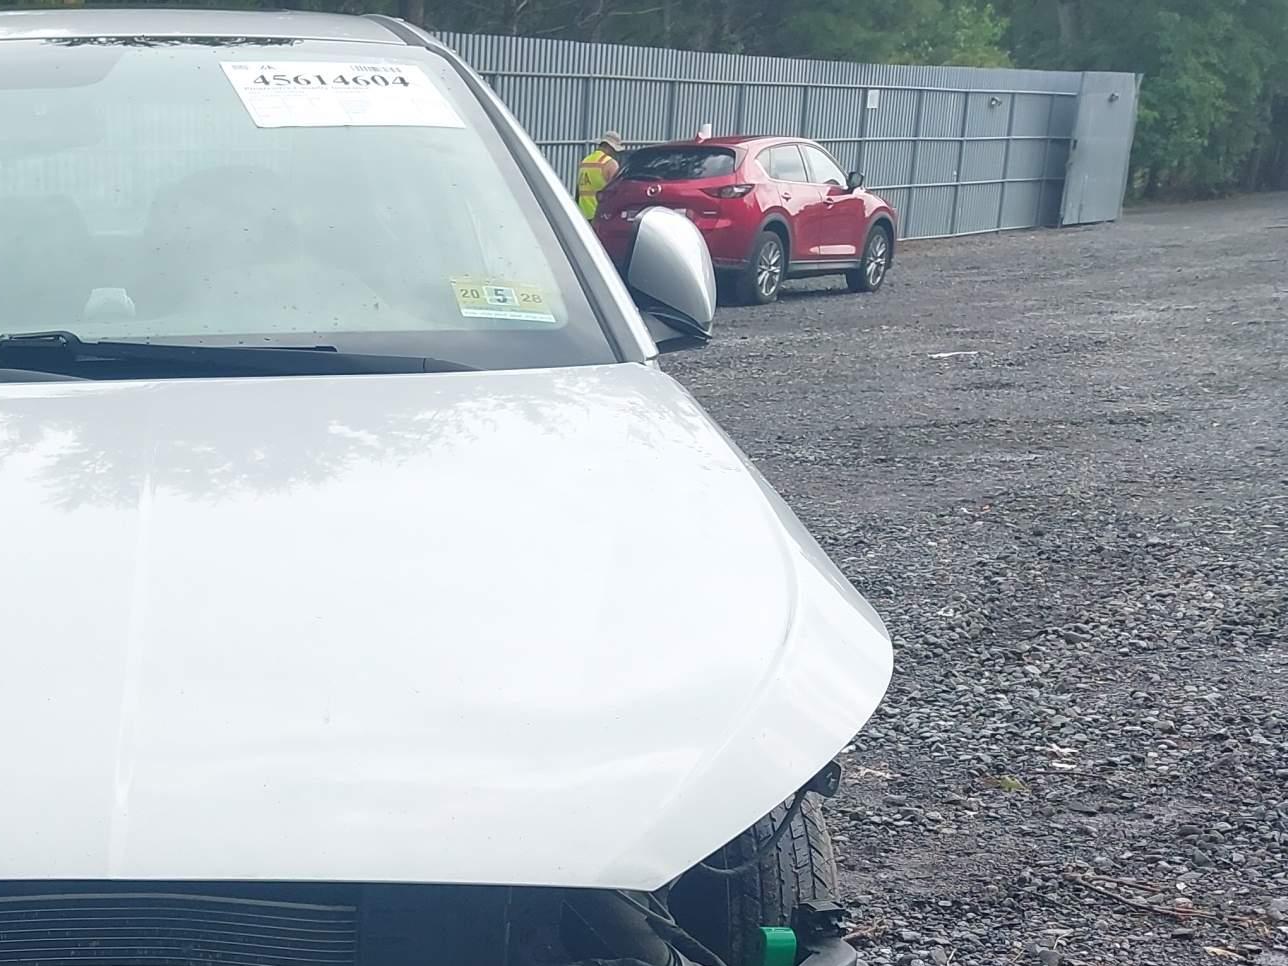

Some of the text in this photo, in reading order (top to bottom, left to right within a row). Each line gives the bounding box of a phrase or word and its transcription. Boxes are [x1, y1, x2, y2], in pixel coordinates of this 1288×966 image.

[253, 74, 410, 87] 45614604
[460, 288, 481, 299] 20
[494, 288, 508, 303] 5
